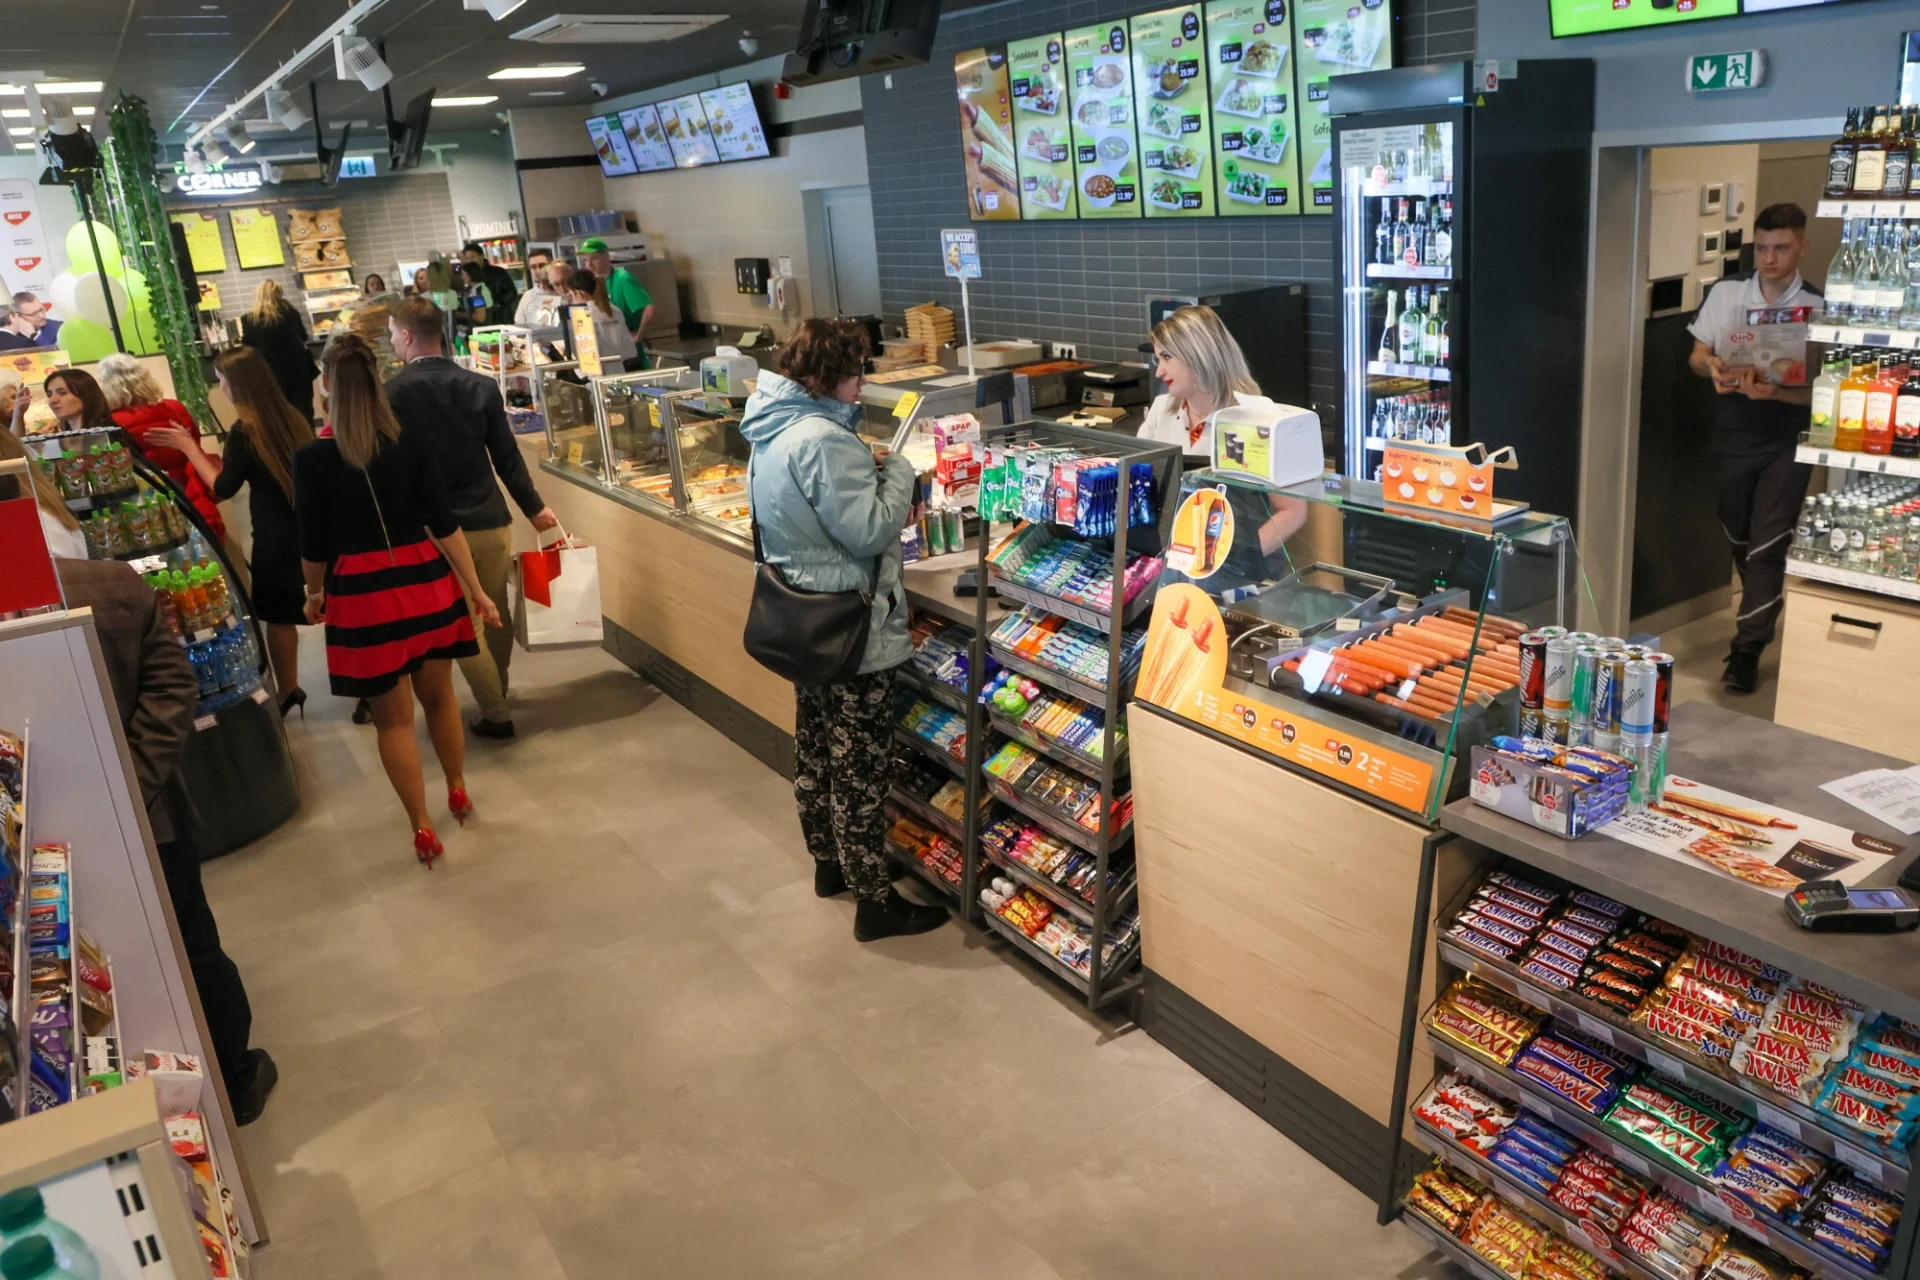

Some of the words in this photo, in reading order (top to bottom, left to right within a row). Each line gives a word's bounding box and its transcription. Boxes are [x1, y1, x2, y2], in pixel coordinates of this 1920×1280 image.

[177, 171, 263, 191] CORNER
[7, 212, 24, 221] MOL
[18, 258, 35, 267] MOL
[950, 422, 971, 433] APAP
[1195, 690, 1204, 707] 1
[1356, 752, 1369, 771] 2
[1789, 853, 1836, 871] CORNER
[1484, 903, 1538, 930] SNICKERS
[1492, 890, 1544, 916] SNICKERS
[1475, 915, 1526, 944] SNICKERS
[1554, 919, 1602, 946] SNICKERS
[1461, 929, 1513, 959] SNICKERS
[1542, 933, 1588, 960] SNICKERS
[1526, 962, 1573, 988] SNICKERS
[1538, 950, 1581, 978] SNICKERS
[1692, 952, 1752, 991] TWIX
[1747, 985, 1774, 1004] Xtr
[1667, 991, 1730, 1028] TWIX
[1719, 1024, 1744, 1042] Xtr
[1786, 987, 1845, 1022] TWIX
[1483, 1004, 1529, 1044] XXL
[1647, 1007, 1707, 1044] TWIX
[1775, 1011, 1834, 1044] TWIX
[1470, 1025, 1515, 1061] XXL
[1755, 1031, 1812, 1067] TWIX
[1803, 1039, 1833, 1054] white
[1566, 1049, 1617, 1090] XXL
[1745, 1050, 1801, 1089] TWIX
[1845, 1066, 1900, 1100] TWIX
[1459, 1087, 1492, 1108] bueno
[1518, 1056, 1541, 1073] PRINCE
[1538, 1062, 1559, 1079] POLO
[1551, 1070, 1602, 1114] XXL
[1772, 1083, 1801, 1099] white
[1439, 1106, 1474, 1127] bueno
[1665, 1099, 1721, 1146] XXL
[1835, 1090, 1892, 1130] TWIX
[1652, 1122, 1707, 1171] XXL
[1761, 1128, 1809, 1156] Knoppers
[1721, 1170, 1769, 1195] Knoppers
[1495, 1212, 1538, 1242] LION
[1642, 1204, 1678, 1226] KitKat
[1482, 1226, 1524, 1254] LION
[1622, 1231, 1659, 1254] KitKat
